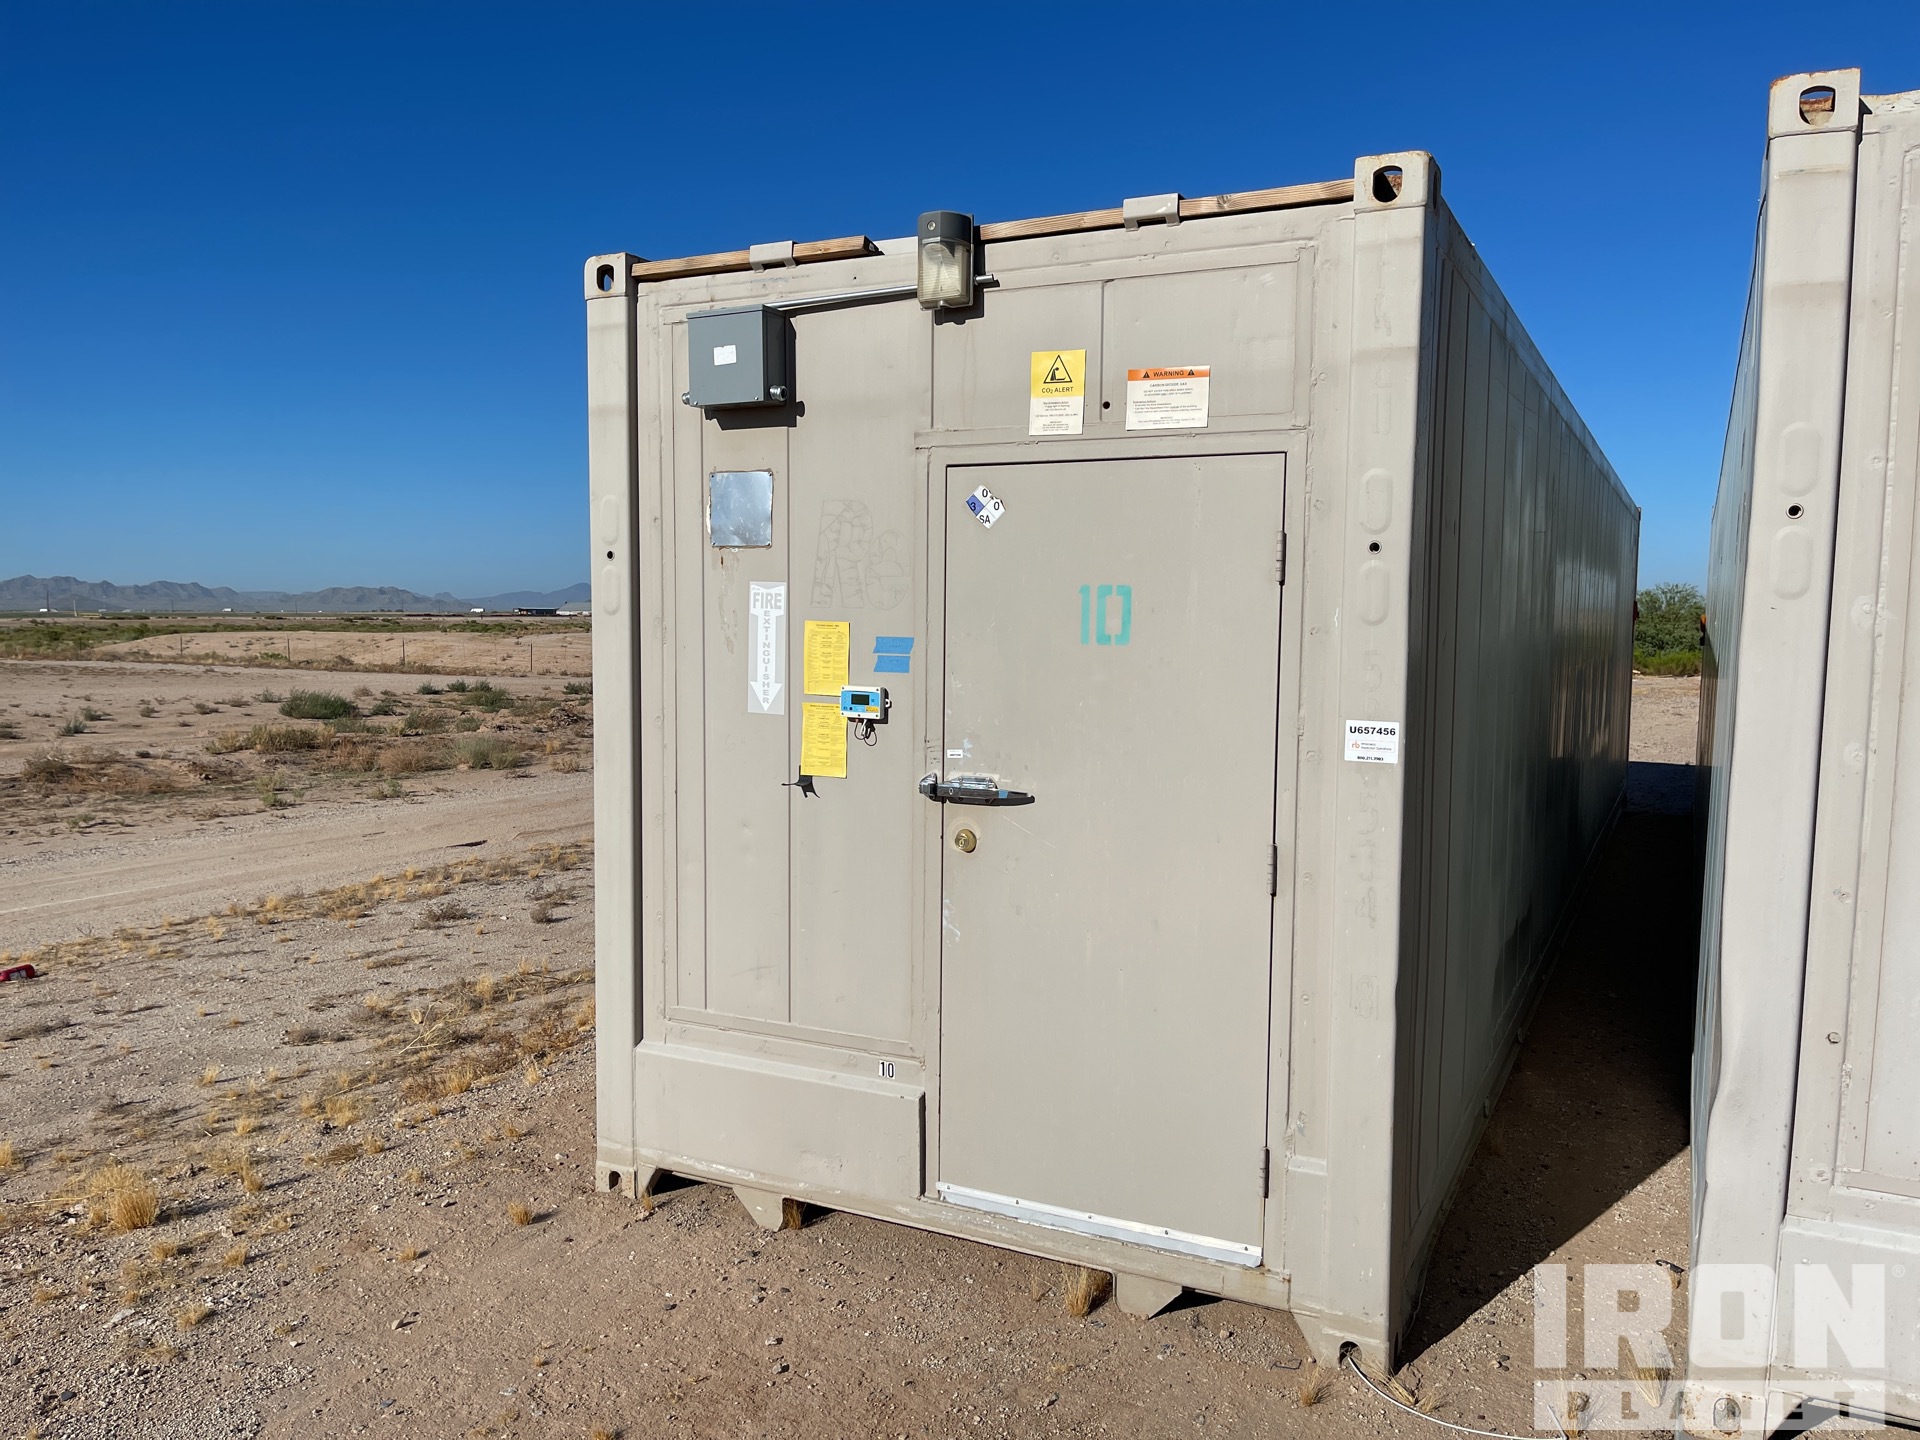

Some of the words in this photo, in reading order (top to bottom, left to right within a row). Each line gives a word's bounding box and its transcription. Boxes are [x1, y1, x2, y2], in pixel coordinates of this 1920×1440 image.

[1153, 369, 1184, 378] WARNING
[982, 488, 988, 498] 0
[970, 502, 976, 511] 3
[993, 501, 1000, 511] 0
[979, 514, 991, 524] SA
[752, 591, 782, 610] FIRE
[1078, 584, 1132, 646] 10
[762, 610, 771, 704] EXTINGUISHER
[1349, 726, 1396, 736] U657456
[880, 1061, 894, 1078] 10
